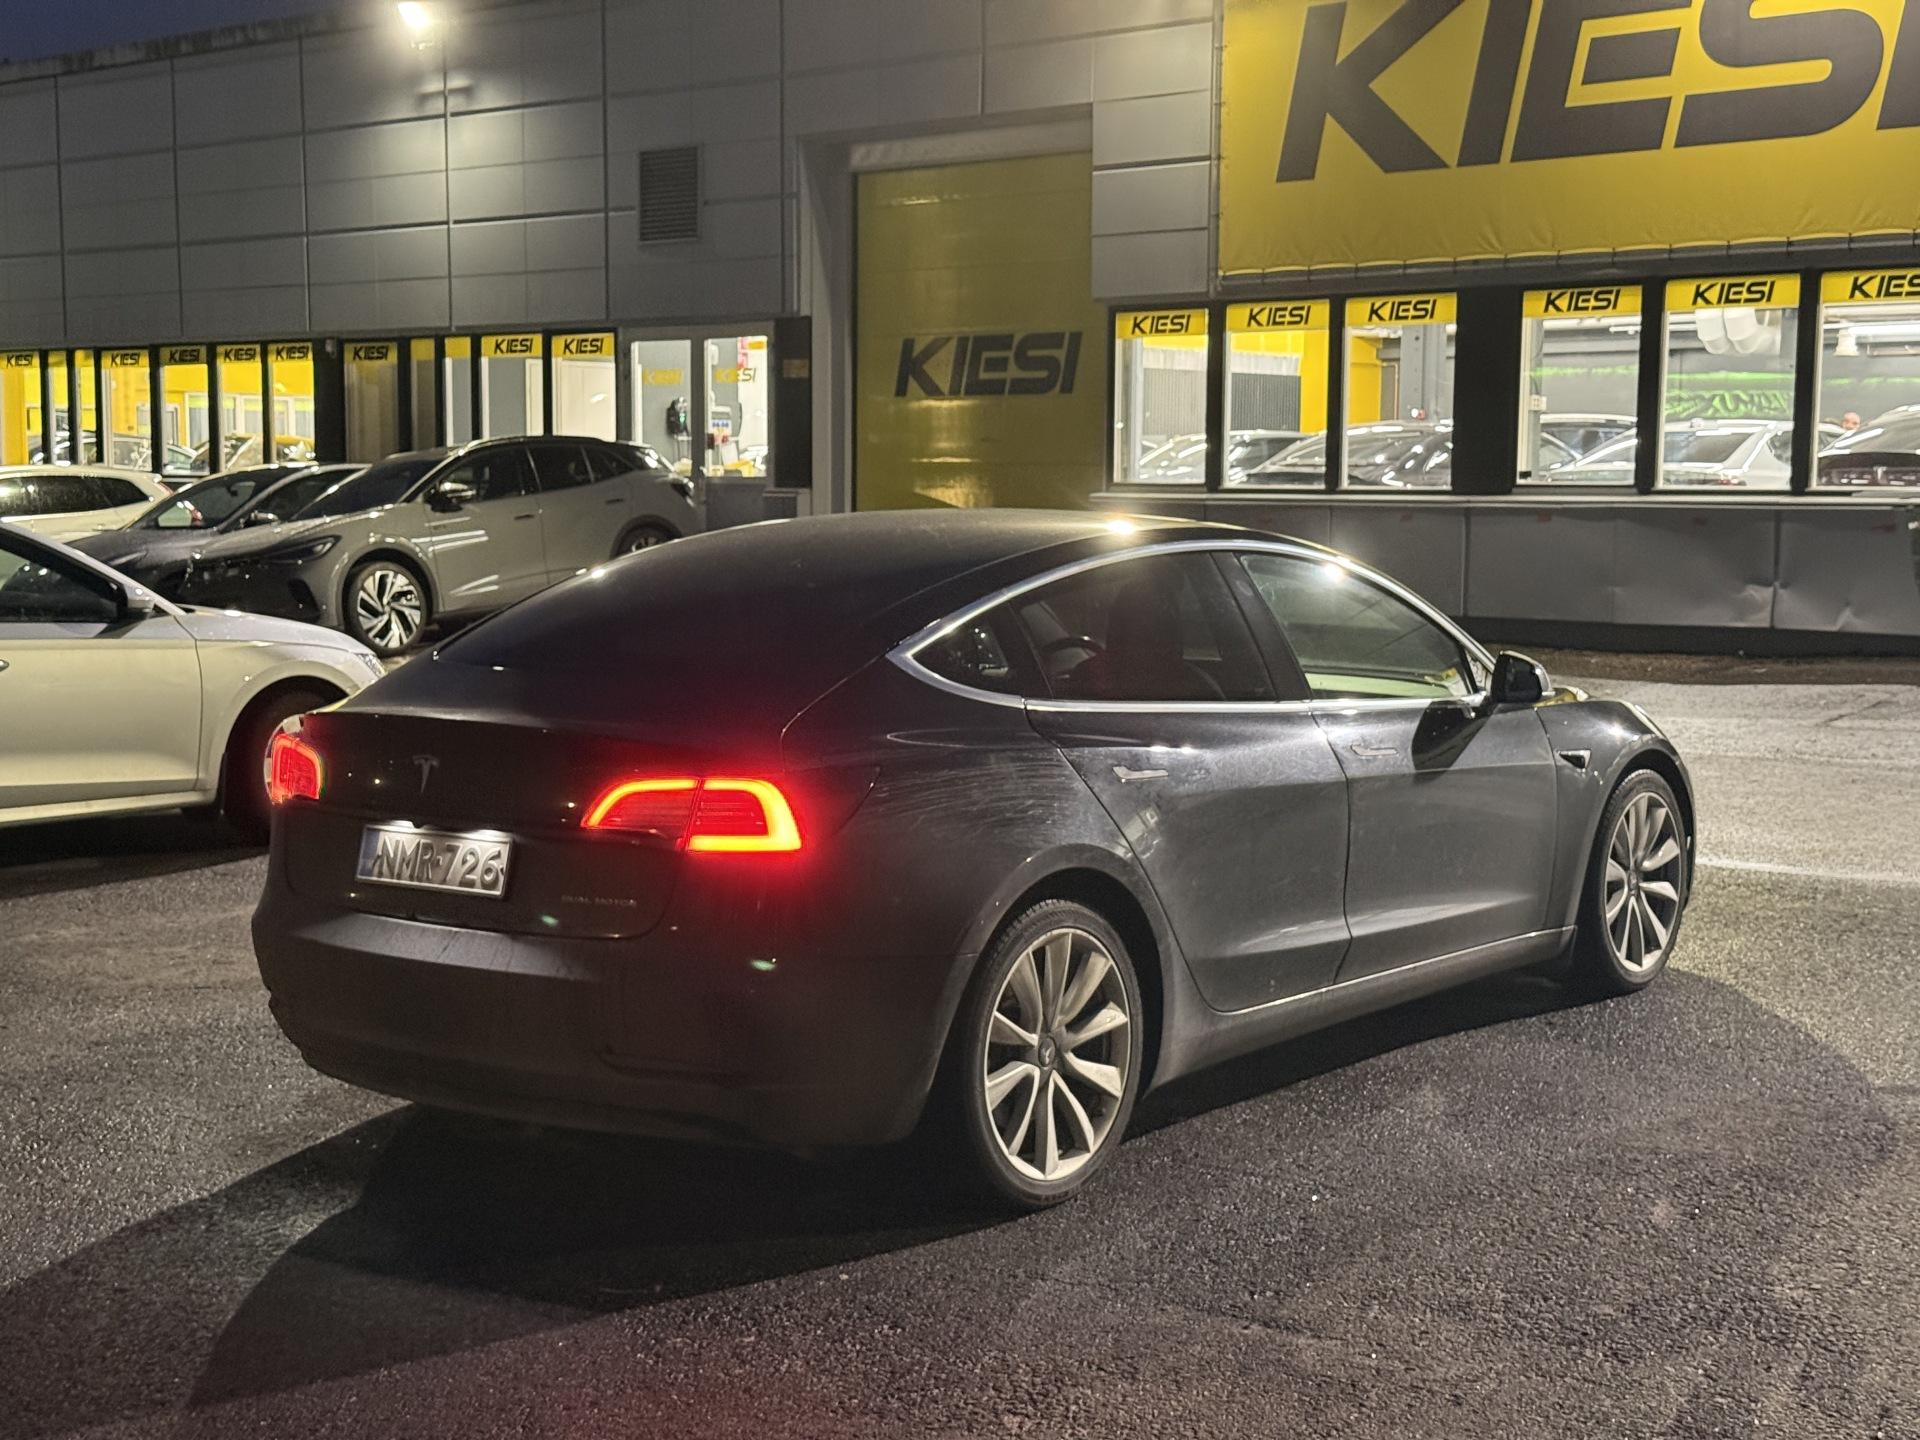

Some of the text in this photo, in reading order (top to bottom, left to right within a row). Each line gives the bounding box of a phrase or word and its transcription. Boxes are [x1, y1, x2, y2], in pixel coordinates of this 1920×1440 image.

[1543, 288, 1621, 313] KIESI
[1692, 280, 1776, 306] KIESI
[1247, 305, 1311, 328] KIESI
[1368, 299, 1437, 322] KIESI
[1132, 314, 1191, 335] KIESI
[223, 348, 257, 361] KIESI
[275, 346, 310, 361] KIESI
[353, 345, 389, 361] KIESI
[494, 338, 533, 355] KIESI
[563, 338, 604, 355] KIESI
[6, 354, 33, 367] KIESI
[110, 353, 141, 367] KIESI
[169, 349, 200, 362] KIESI
[895, 331, 1083, 397] KIESI
